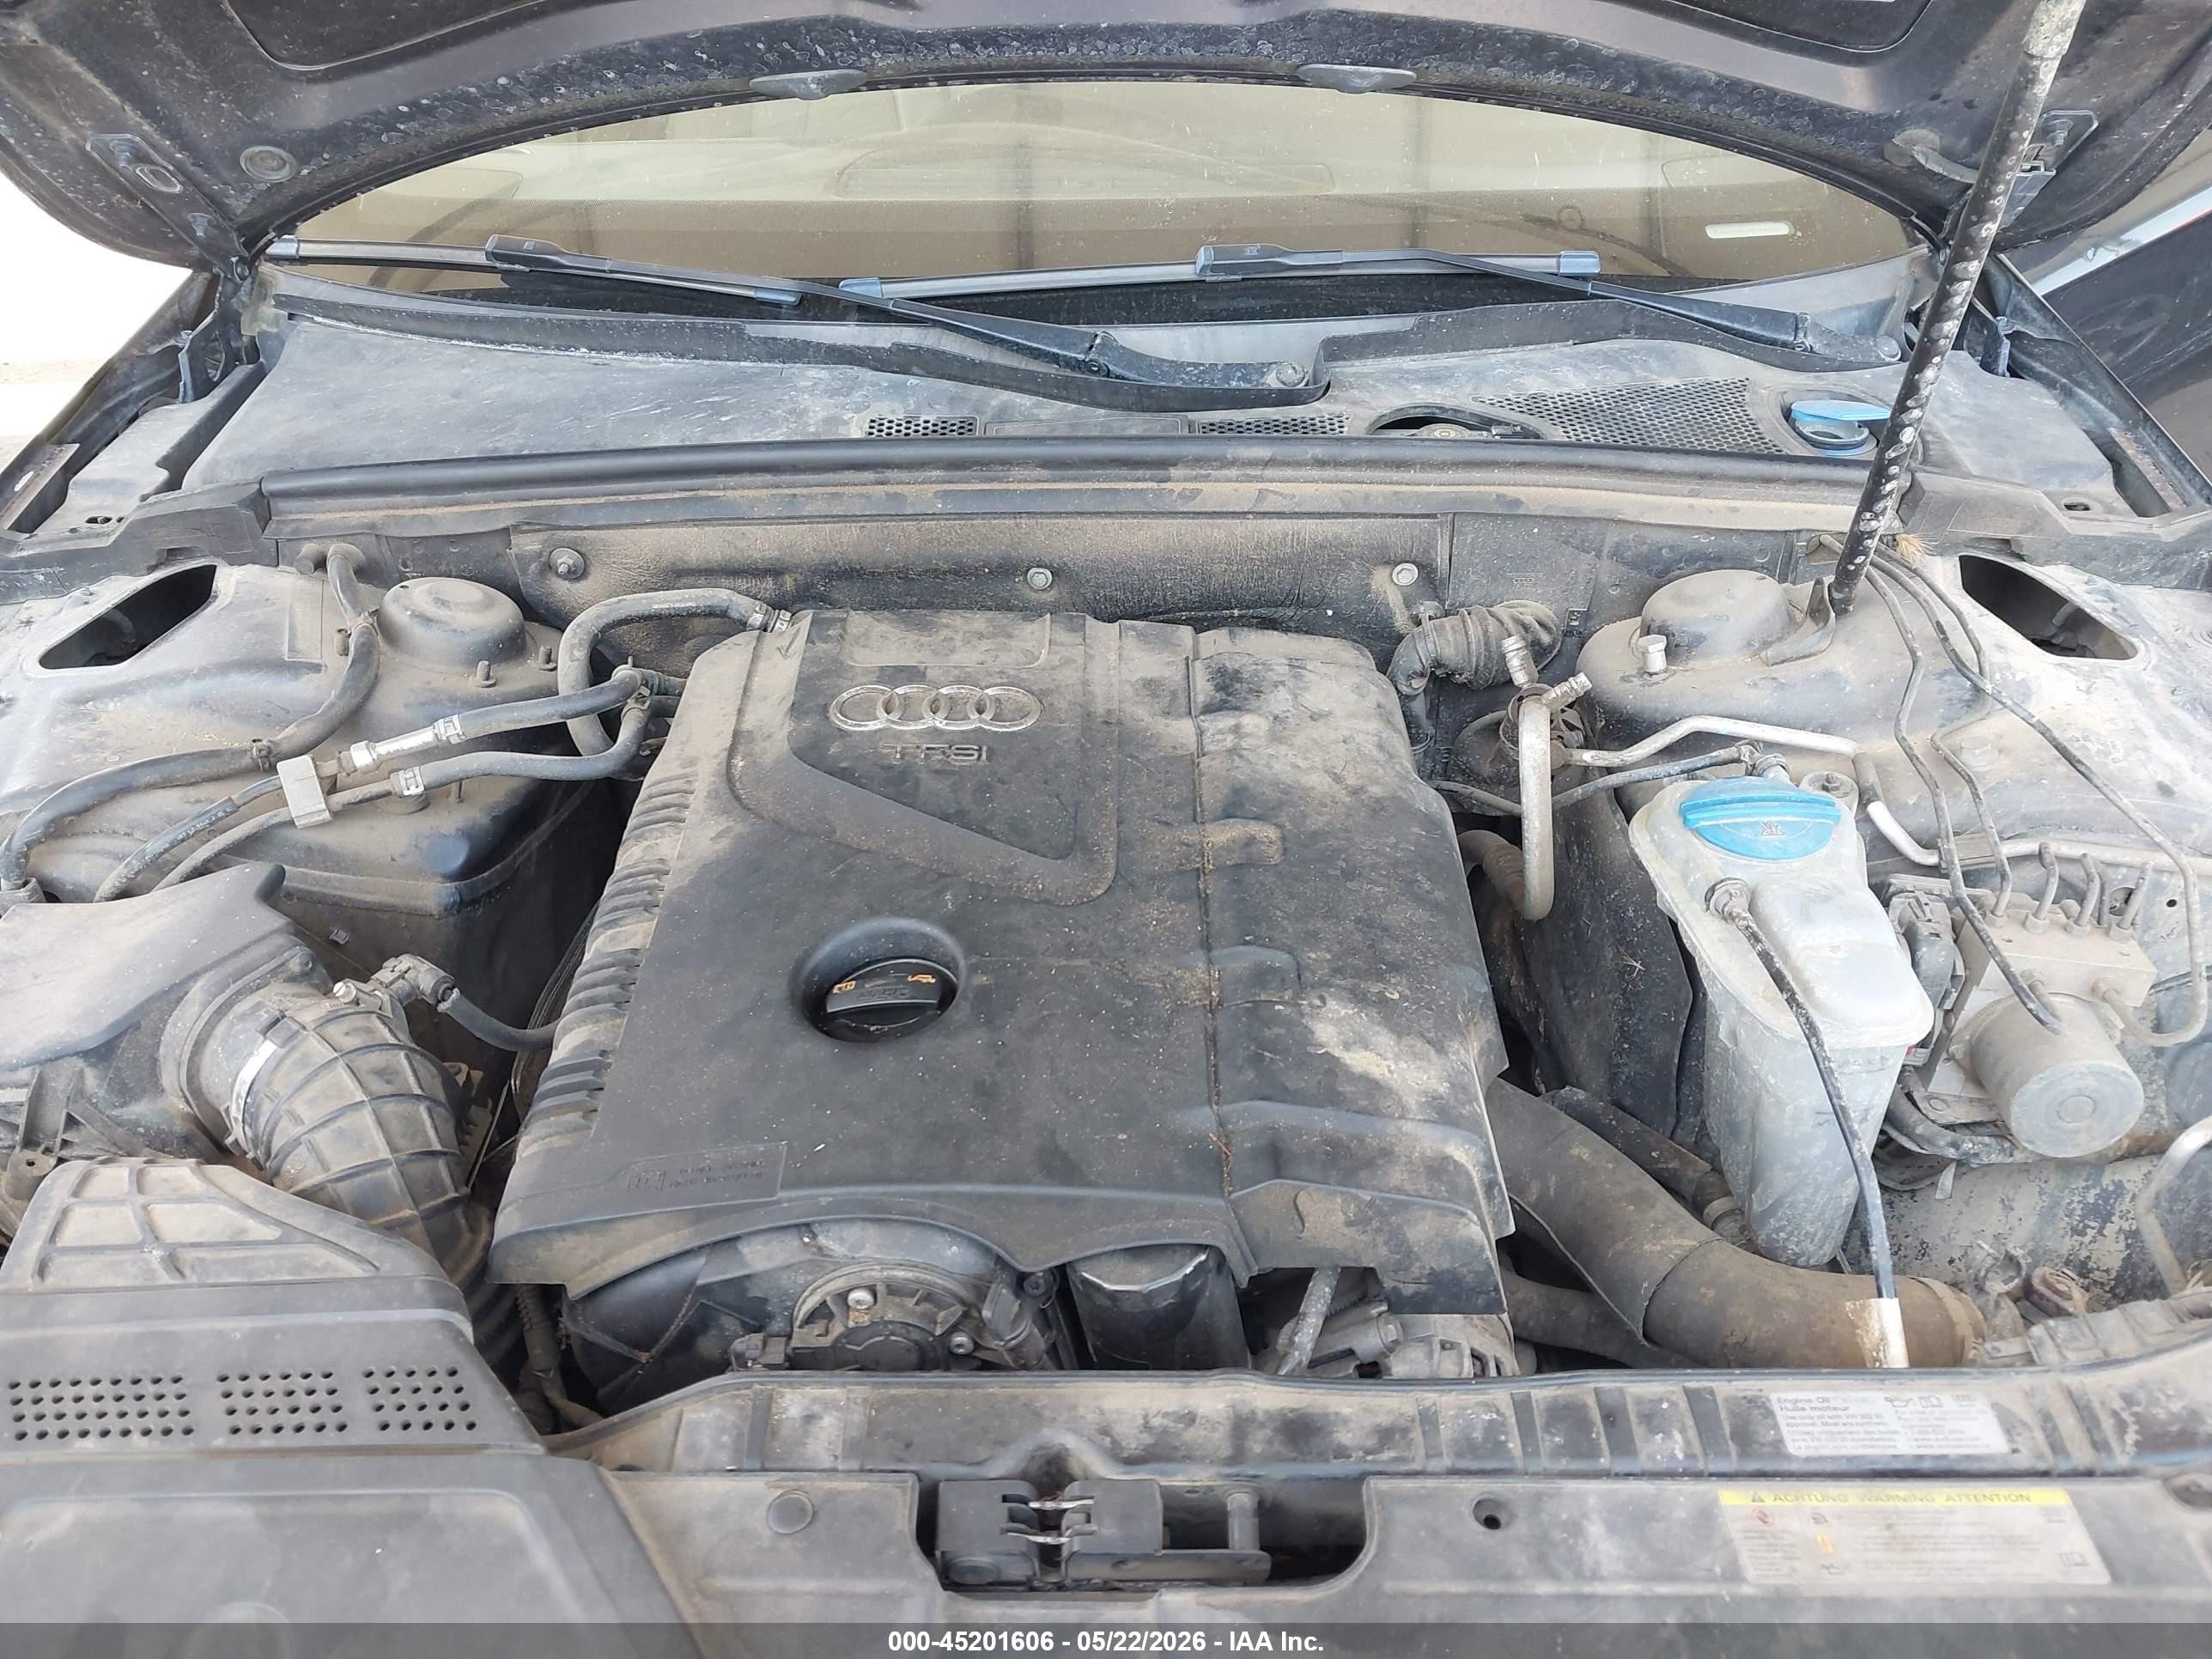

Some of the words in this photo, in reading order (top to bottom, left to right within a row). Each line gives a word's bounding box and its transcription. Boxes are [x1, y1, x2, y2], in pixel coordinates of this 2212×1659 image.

[881, 744, 988, 764] TFSI
[1776, 1396, 1814, 1405] Engine
[1773, 1492, 1848, 1503] ACHTUNG
[1859, 1492, 1935, 1503] WARNING
[1945, 1492, 2032, 1503] ATTENTION
